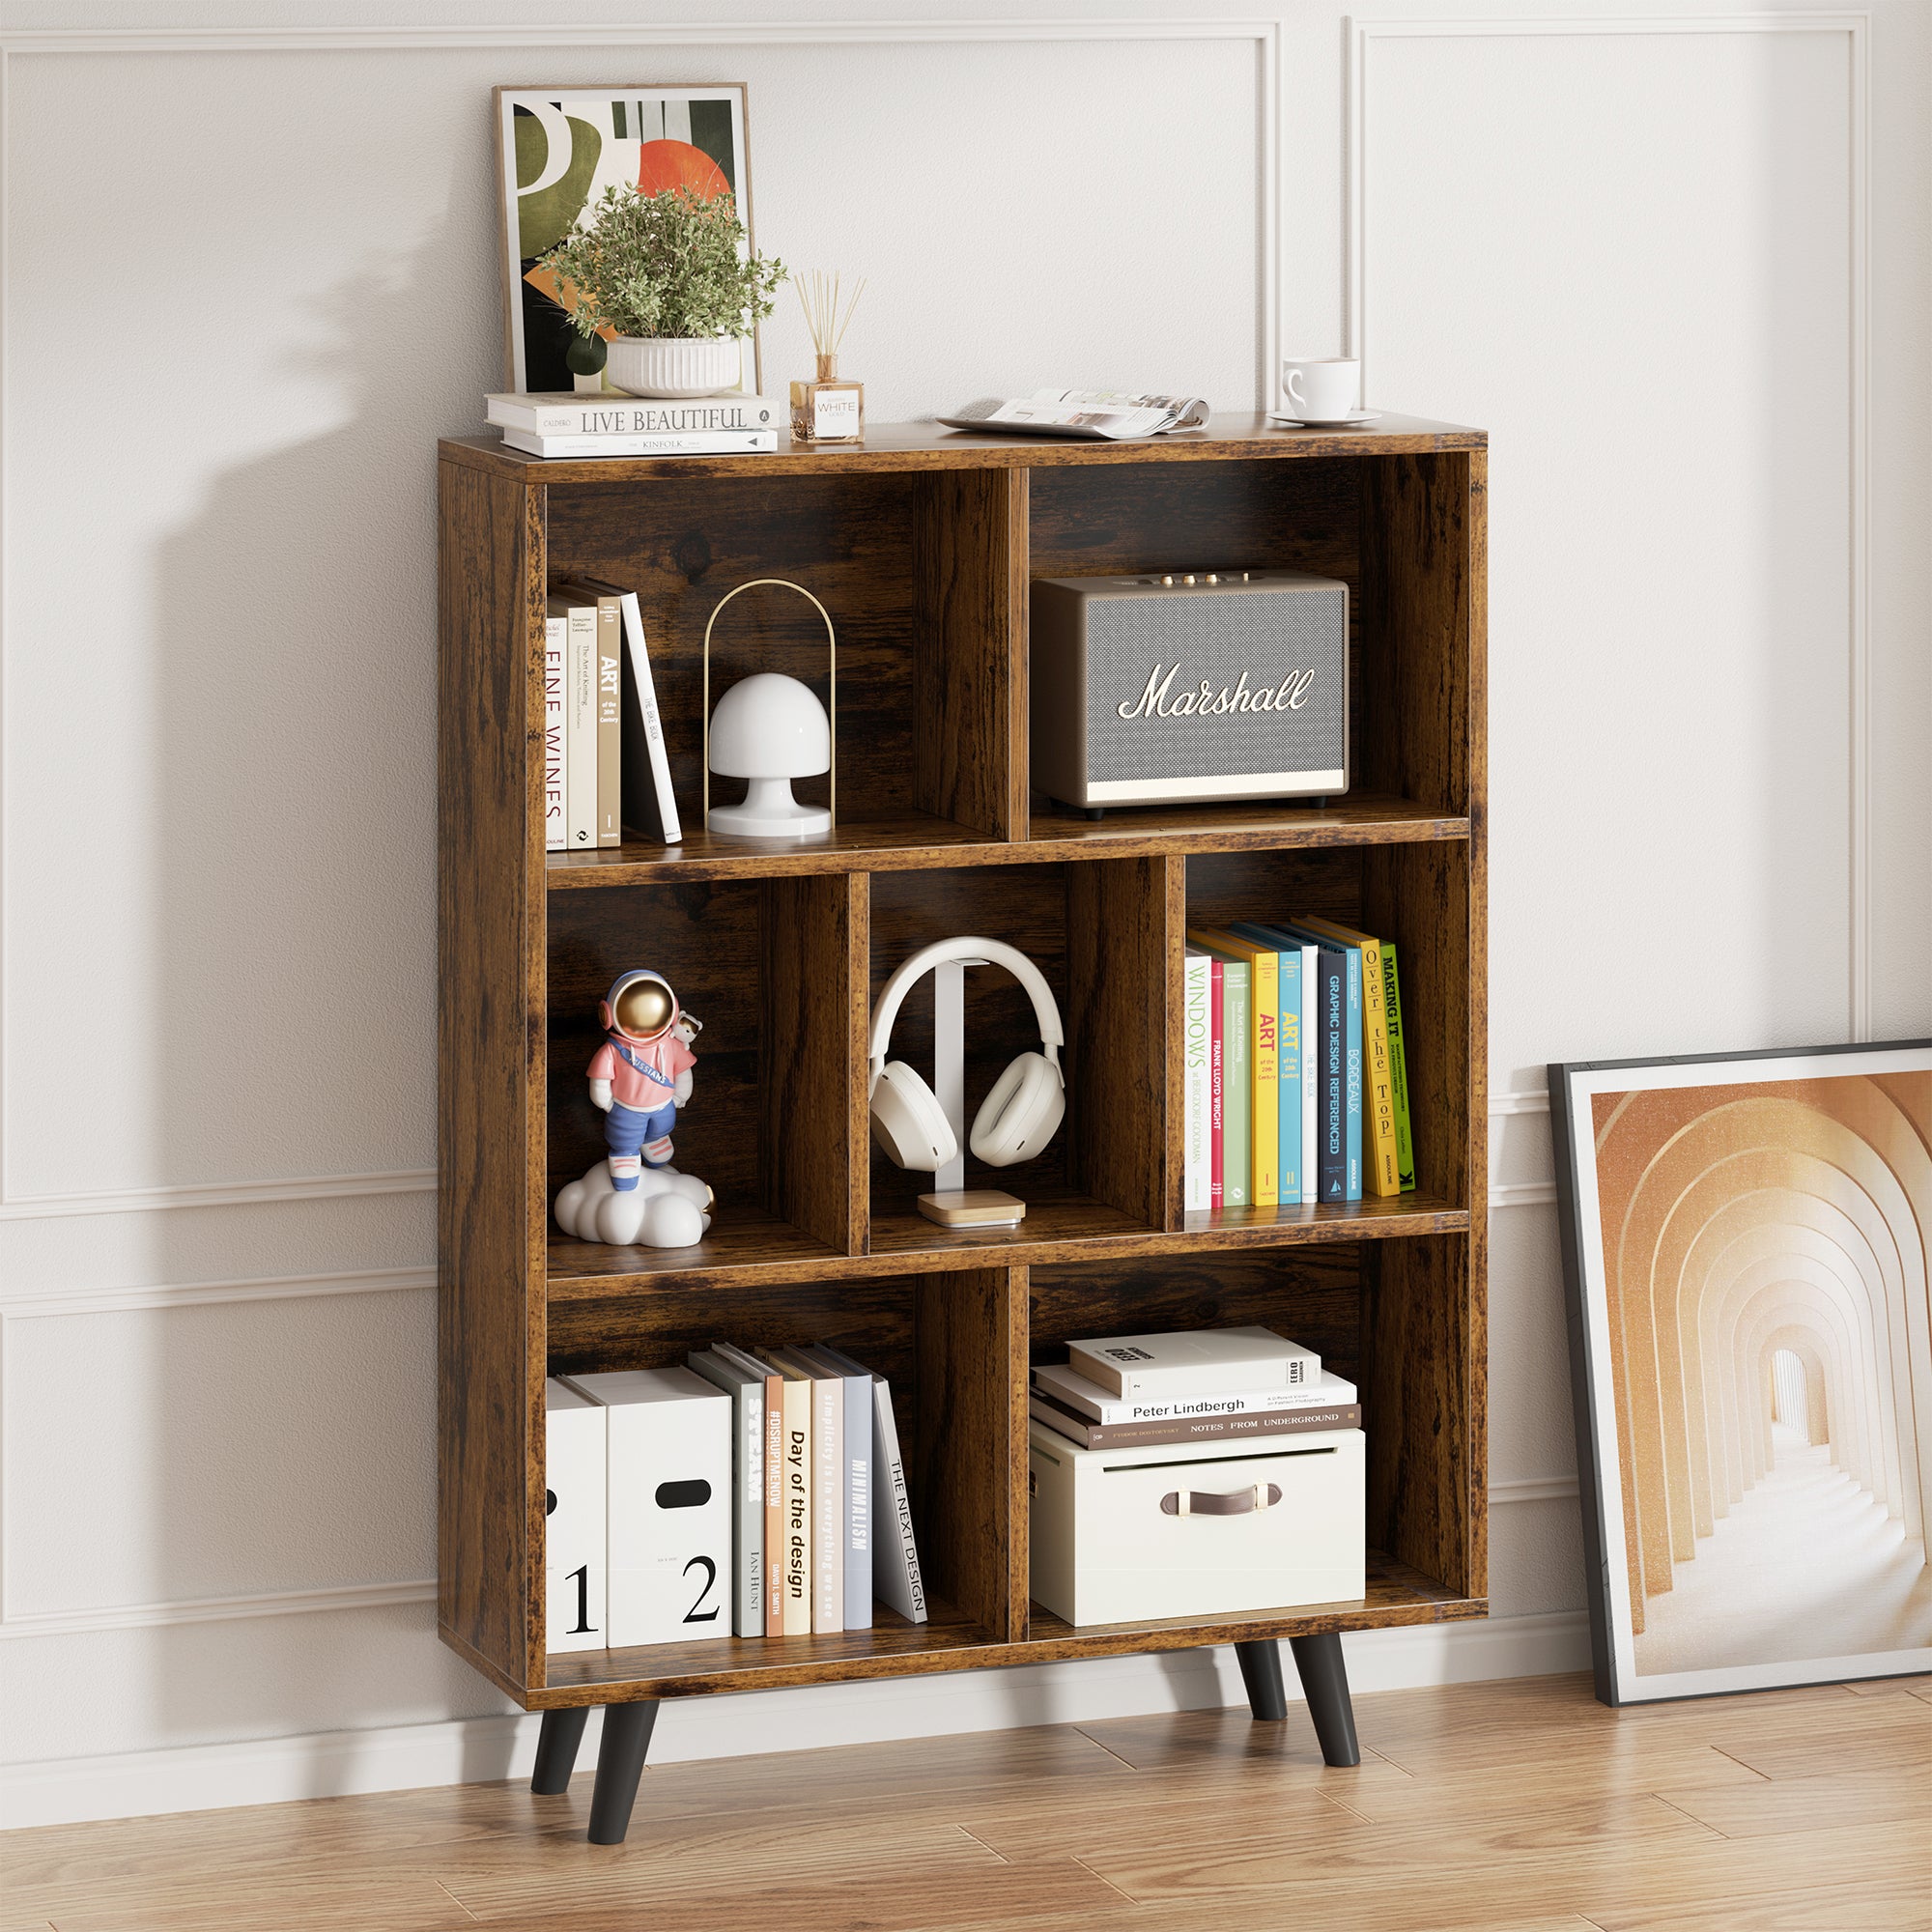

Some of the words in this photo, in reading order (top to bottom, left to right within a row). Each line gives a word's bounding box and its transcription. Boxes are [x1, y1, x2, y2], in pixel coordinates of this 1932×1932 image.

[582, 412, 625, 433] LIVE
[634, 409, 747, 431] BEAUTIFUL
[818, 402, 855, 412] WHITE
[601, 655, 617, 695] ART
[1118, 663, 1315, 719] Marshall
[644, 696, 654, 710] THE
[650, 724, 659, 742] BOOK
[1366, 950, 1378, 1008] Over
[1383, 956, 1398, 1017] MAKING
[1188, 965, 1206, 1068] WINDOWS
[1329, 975, 1340, 1028] GRAPHIC
[1260, 1013, 1275, 1051] ART
[1282, 1011, 1298, 1050] ART
[1375, 1028, 1384, 1069] the
[1388, 1021, 1399, 1037] IT
[634, 1059, 666, 1084] USSIANS
[1329, 1031, 1340, 1074] DESIGN
[1348, 1048, 1359, 1114] BORDEAUX
[1329, 1077, 1340, 1154] REFERENCED
[1377, 1085, 1390, 1134] Top
[822, 1395, 835, 1461] simplicity
[1133, 1406, 1169, 1417] Peter
[1174, 1399, 1244, 1414] Lindbergh
[1190, 1423, 1224, 1433] NOTES
[1230, 1420, 1258, 1430] FROM
[1264, 1413, 1339, 1427] UNDERGROUND
[749, 1398, 761, 1502] STEAM
[770, 1410, 781, 1507] #DISRUPTMENOW
[787, 1431, 805, 1467] Day
[791, 1473, 805, 1493] of
[824, 1465, 835, 1477] is
[824, 1481, 835, 1494] in
[892, 1459, 905, 1492] THE
[791, 1498, 805, 1529] the
[852, 1459, 867, 1550] MINIMALISM
[897, 1497, 913, 1541] NEXT
[822, 1499, 835, 1569] everything
[751, 1551, 759, 1574] IAN
[787, 1536, 805, 1599] design
[824, 1574, 833, 1592] we
[905, 1548, 924, 1611] DESIGN
[564, 1564, 599, 1634] 1
[682, 1555, 721, 1624] 2
[751, 1577, 759, 1612] HUNT
[824, 1596, 833, 1617] see
